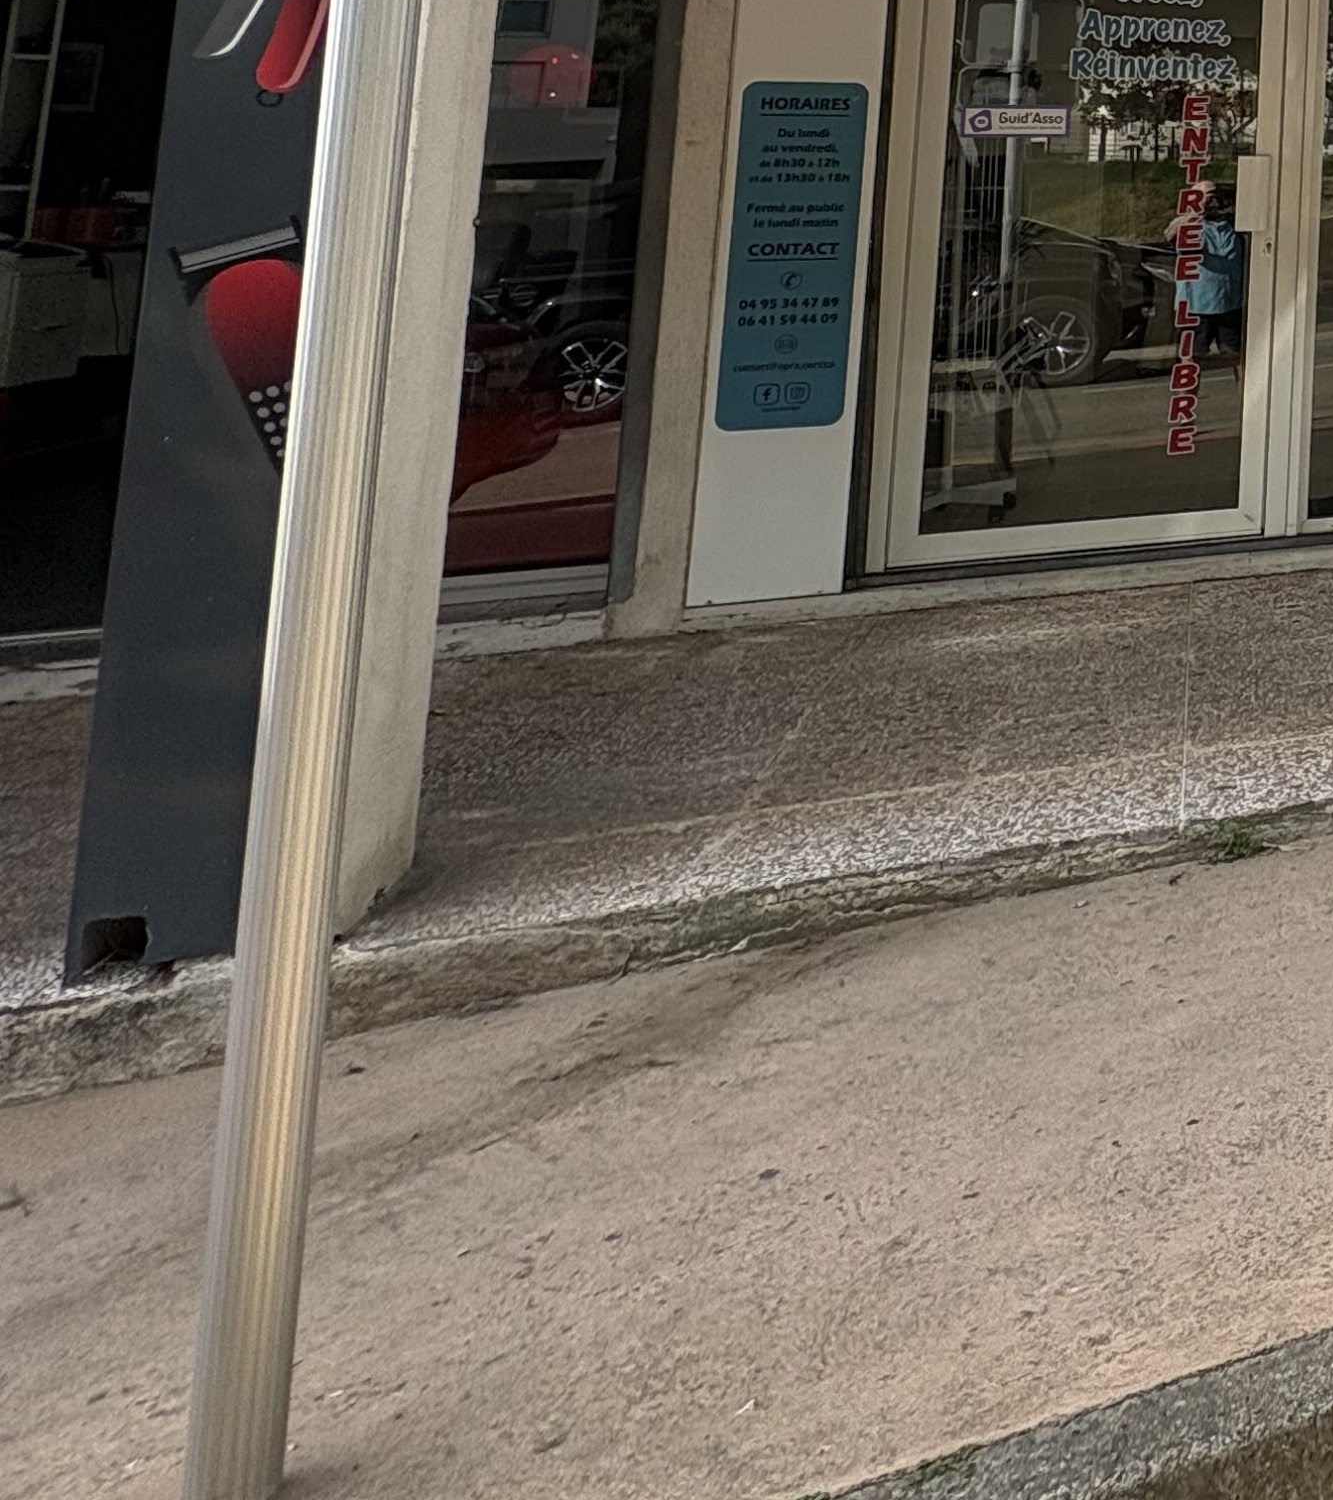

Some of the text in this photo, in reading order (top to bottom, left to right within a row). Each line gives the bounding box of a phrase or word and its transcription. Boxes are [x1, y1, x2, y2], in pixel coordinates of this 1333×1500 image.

[1078, 9, 1232, 48] Apprenez,
[1069, 48, 1237, 81] Réinventez
[761, 97, 850, 111] HORAIRES
[798, 128, 831, 138] lundi
[748, 242, 841, 257] CONTACT
[740, 296, 839, 310] 04 95 34 47 89
[738, 312, 838, 327] 06 41 59 44 09
[1165, 298, 1203, 458] LIBRE
